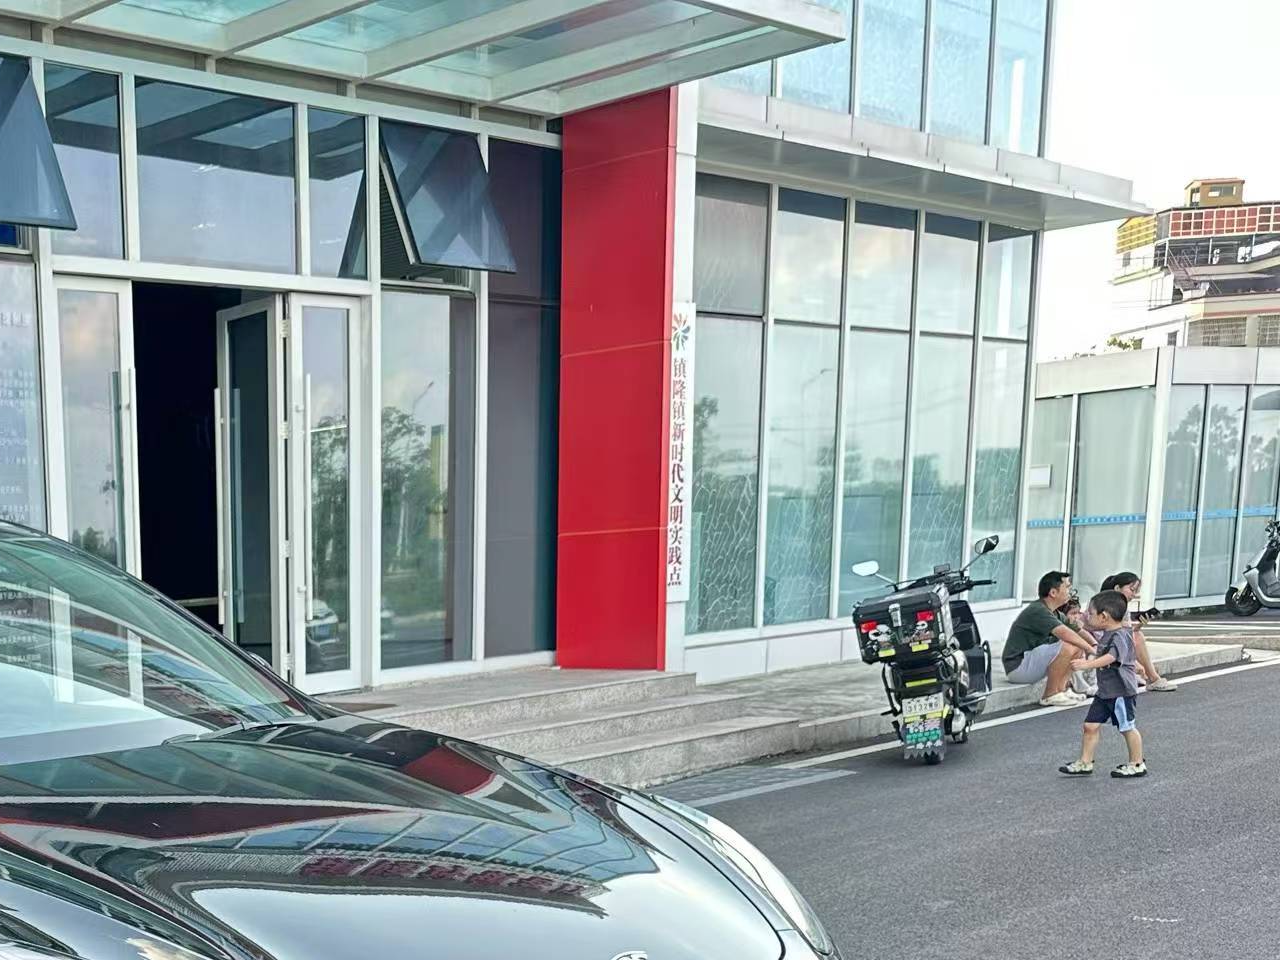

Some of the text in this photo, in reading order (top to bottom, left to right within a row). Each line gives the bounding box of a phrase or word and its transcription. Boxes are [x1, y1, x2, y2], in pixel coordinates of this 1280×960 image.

[667, 357, 687, 587] 镇隆镇新时代文明实践点
